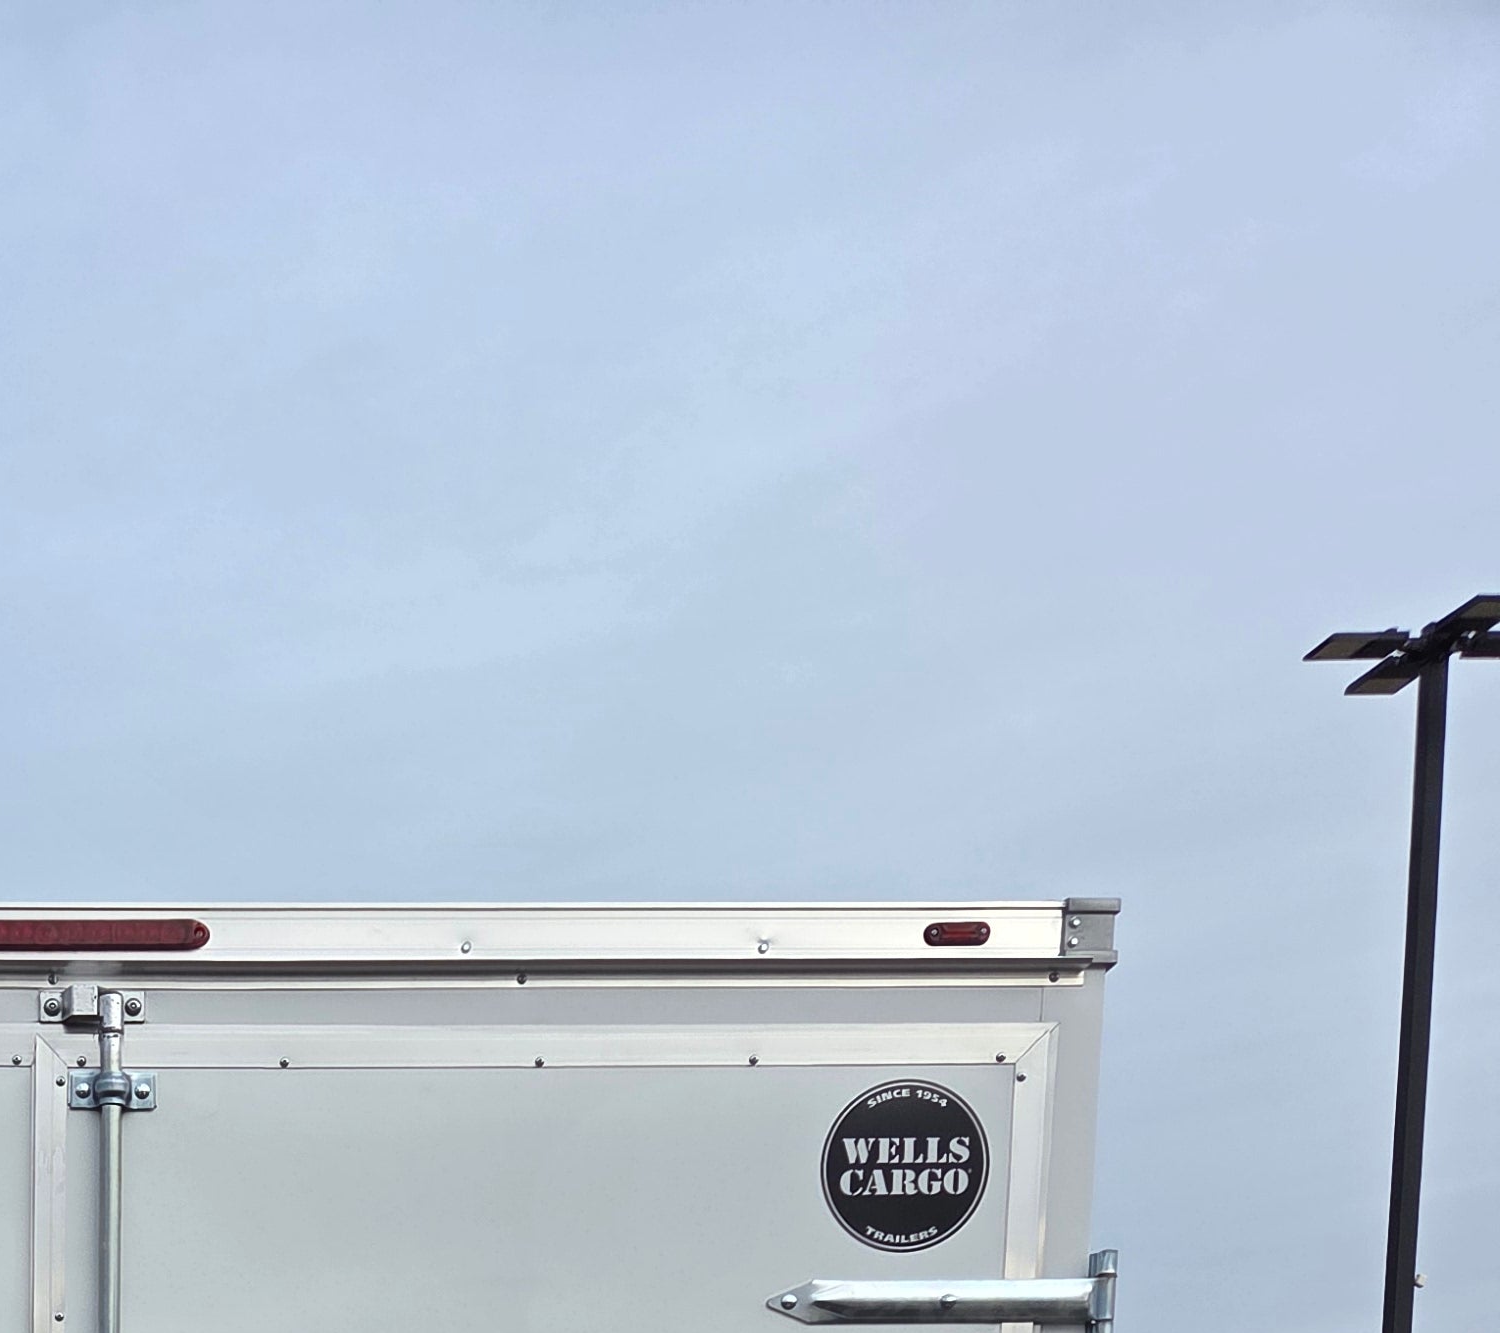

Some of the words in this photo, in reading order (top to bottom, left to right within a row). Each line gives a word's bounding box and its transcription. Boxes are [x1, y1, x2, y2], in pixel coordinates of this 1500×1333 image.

[867, 1088, 911, 1108] SINCE
[915, 1089, 949, 1107] 1954
[842, 1136, 971, 1165] WELLS
[839, 1168, 970, 1196] CARGO
[865, 1225, 939, 1244] TRAILERS
